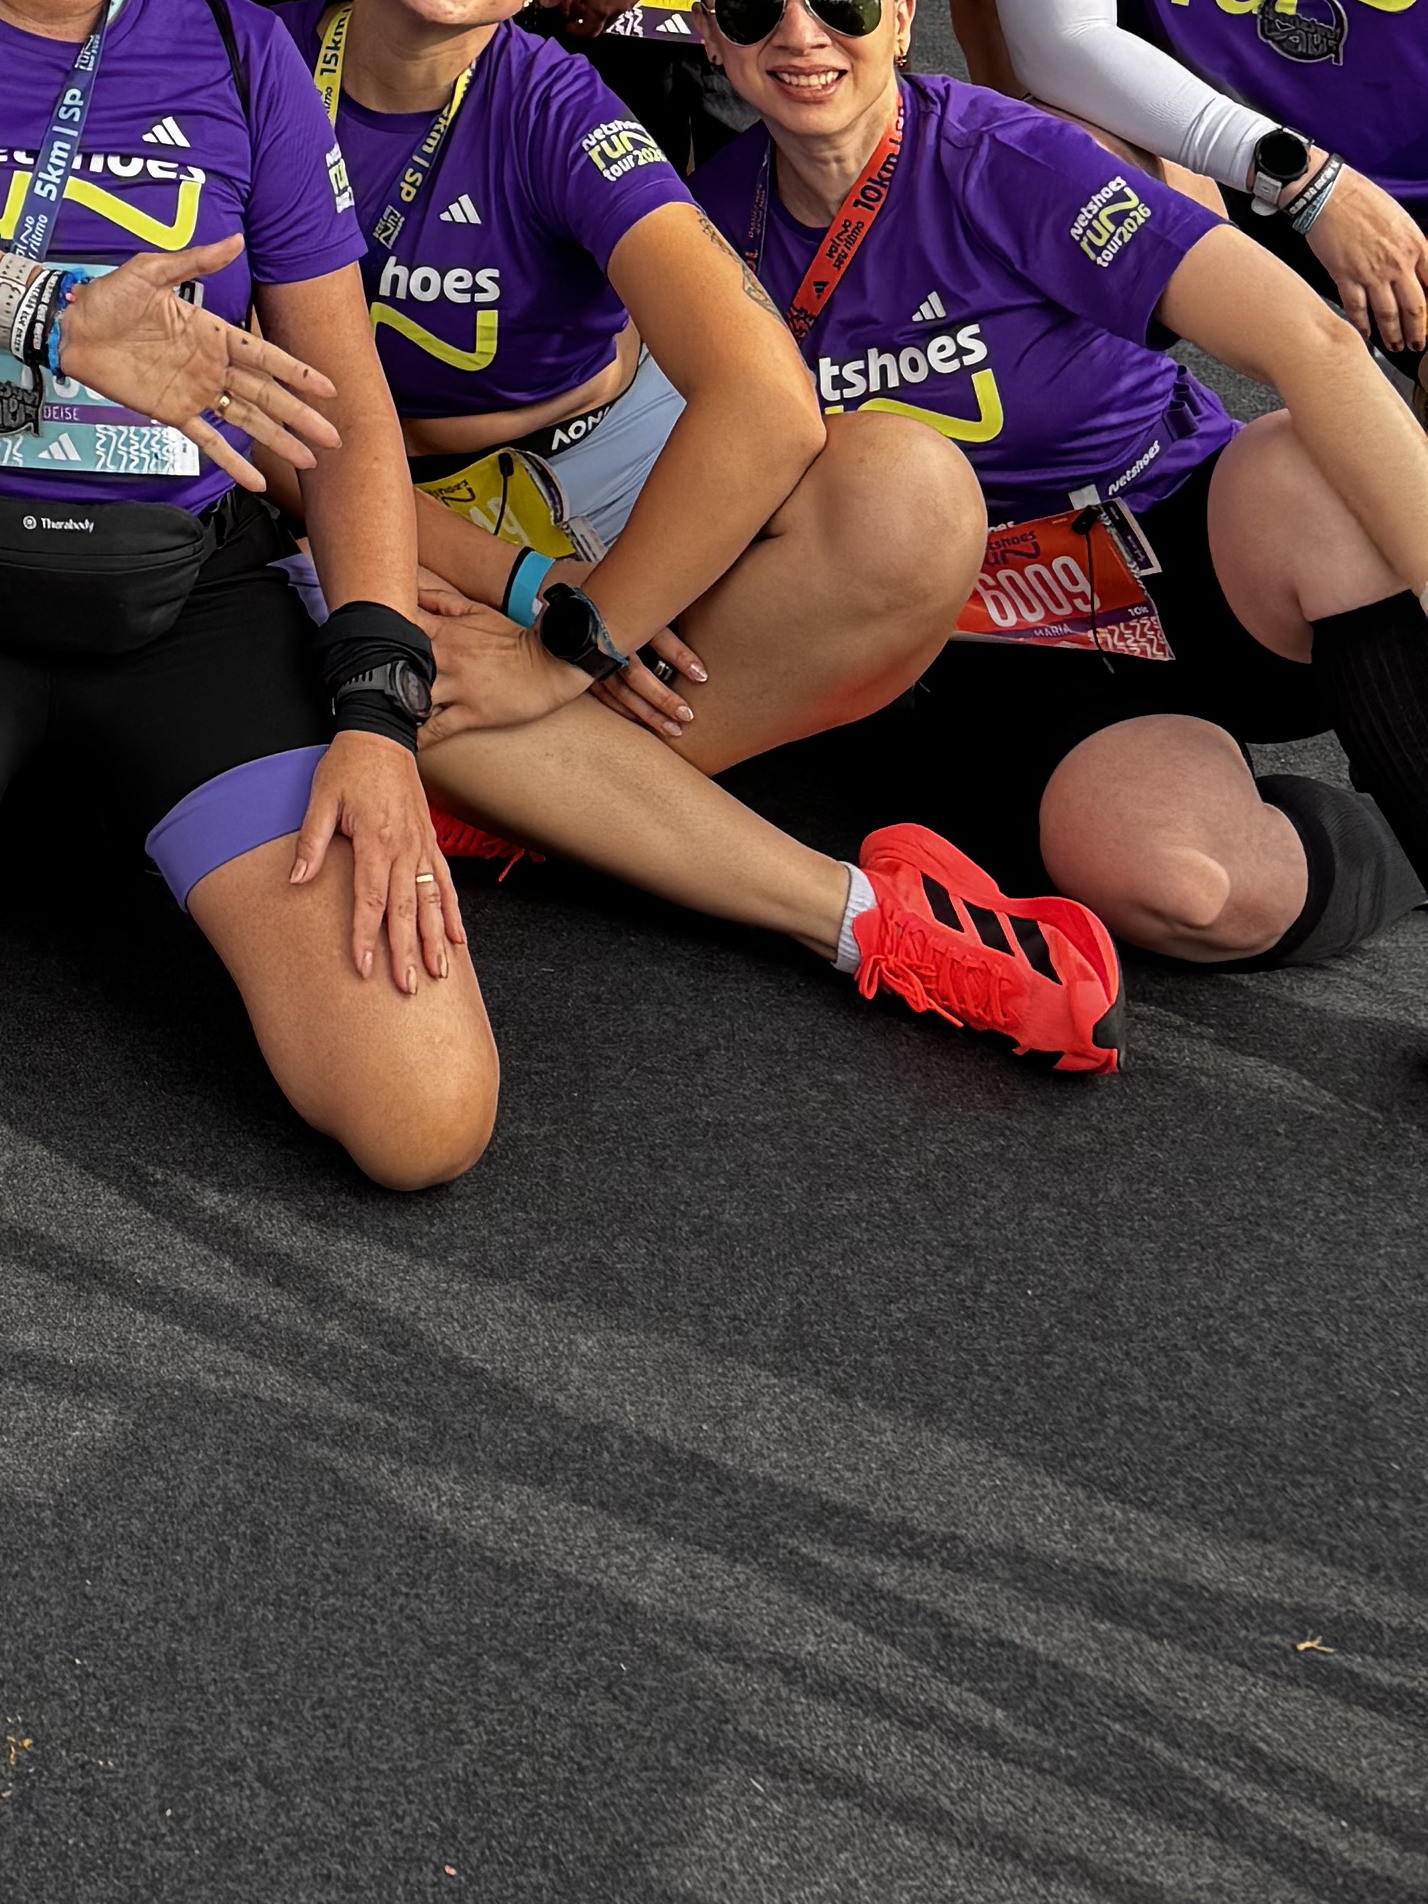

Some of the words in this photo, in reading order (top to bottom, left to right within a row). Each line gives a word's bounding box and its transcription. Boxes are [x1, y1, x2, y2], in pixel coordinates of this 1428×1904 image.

[318, 14, 348, 78] 15km
[33, 142, 72, 202] 5km
[57, 87, 82, 123] SP
[587, 130, 659, 172] run
[601, 157, 636, 183] tour
[399, 166, 424, 204] SP
[853, 153, 900, 213] 10km
[1068, 175, 1128, 243] Netshoes
[1078, 186, 1140, 262] run
[1096, 234, 1124, 269] tour
[1117, 202, 1152, 243] 2026
[378, 255, 501, 304] hoes
[818, 323, 989, 401] tshoes
[43, 404, 81, 423] DEISE
[1107, 440, 1161, 496] Netshoes
[40, 516, 95, 534] Therabody
[975, 555, 1102, 628] 6009
[1033, 623, 1074, 638] MARIA
